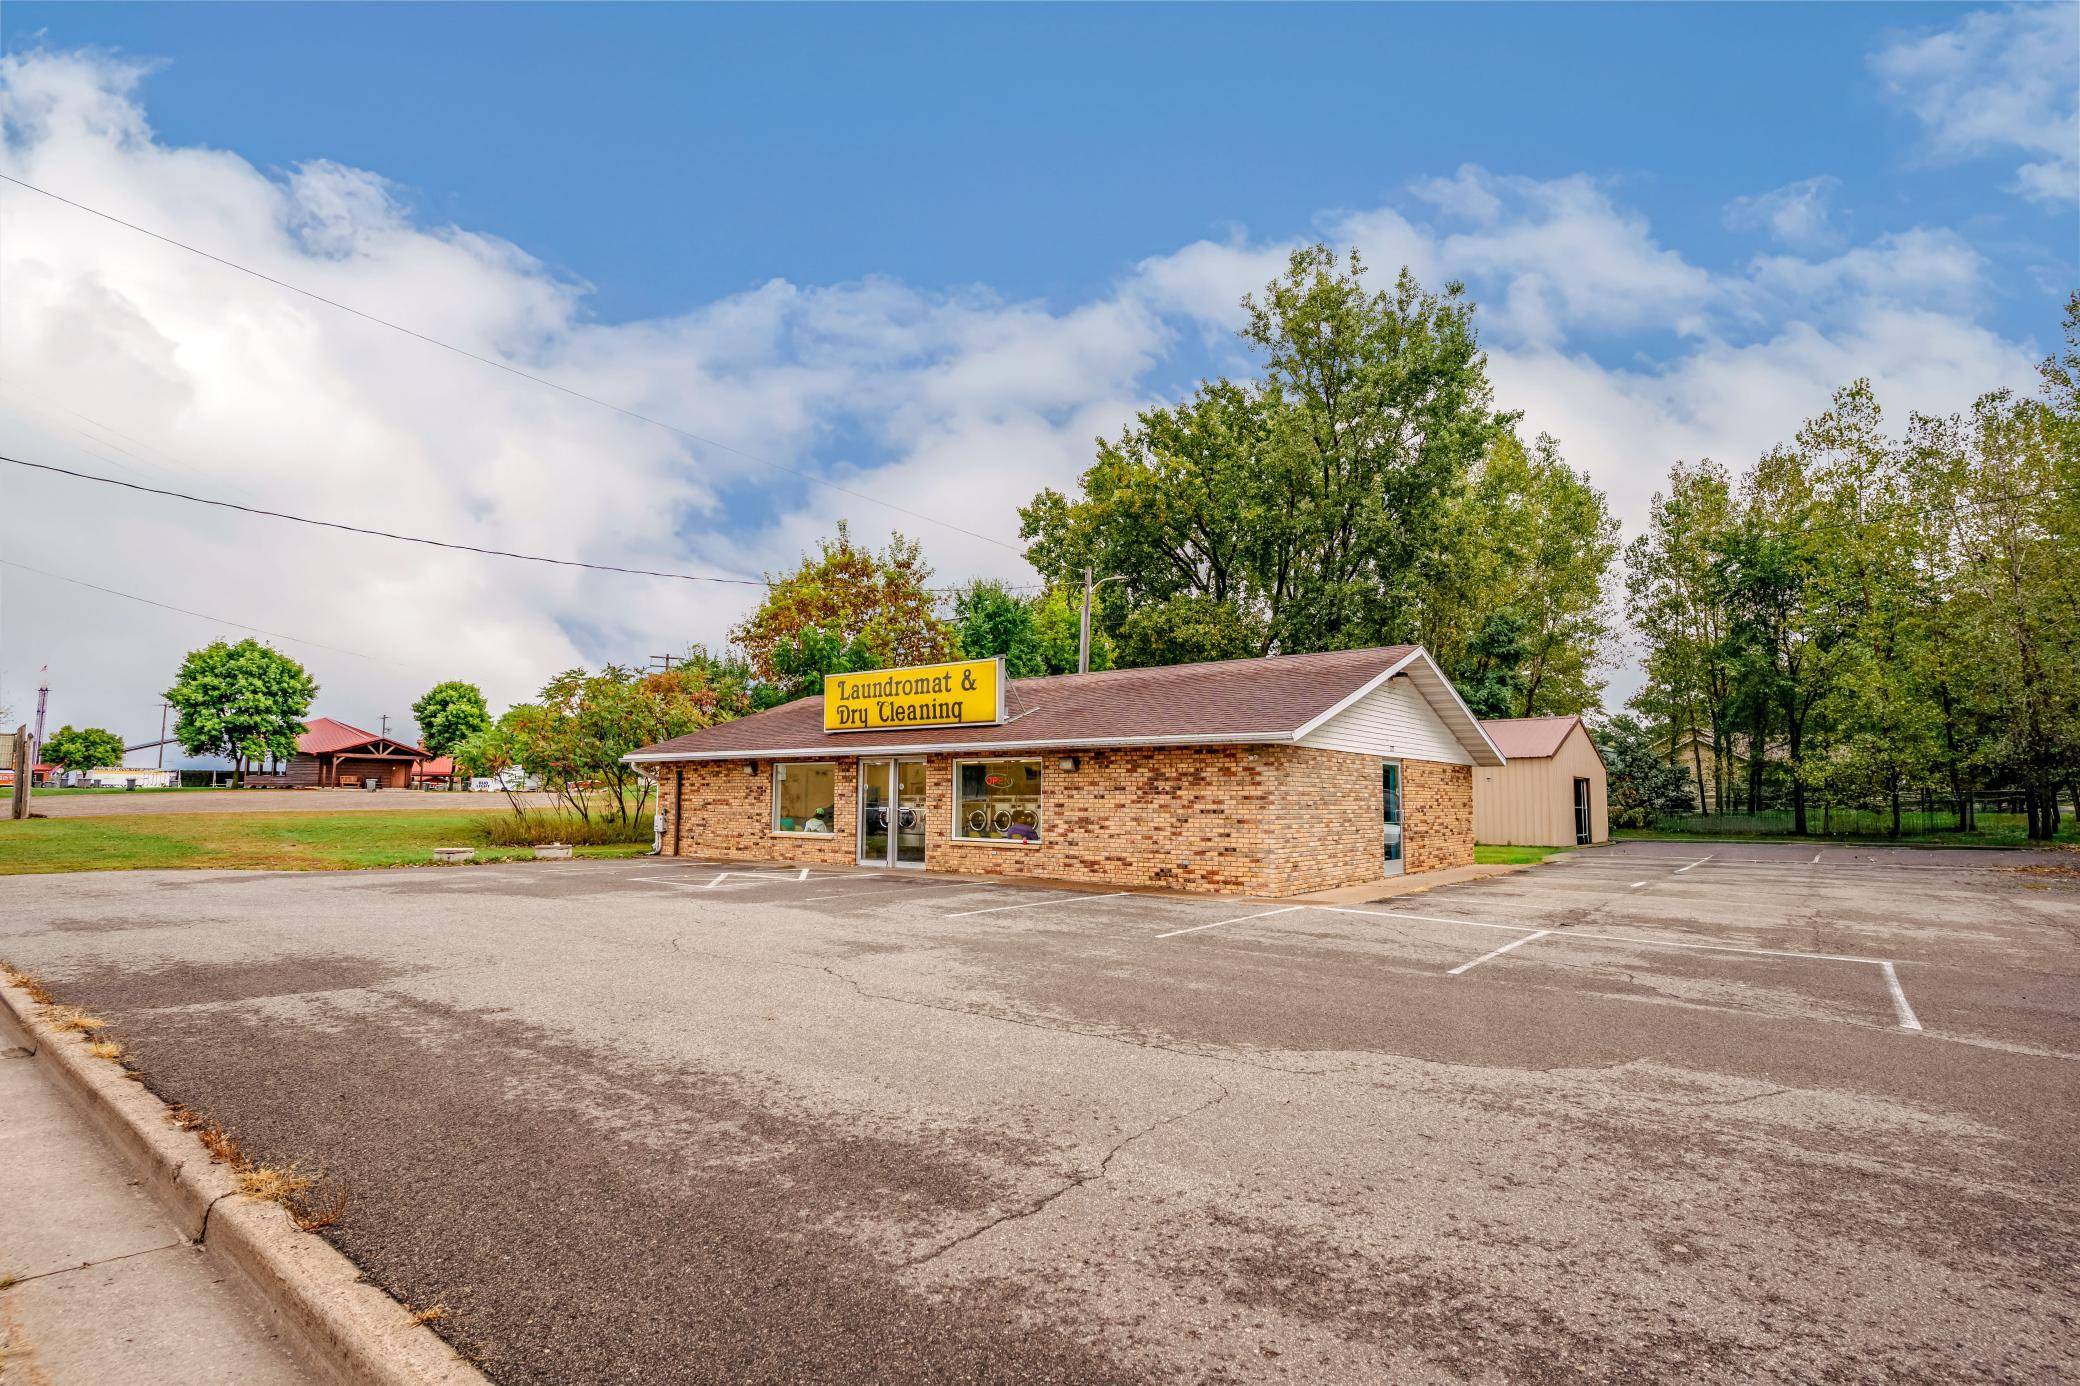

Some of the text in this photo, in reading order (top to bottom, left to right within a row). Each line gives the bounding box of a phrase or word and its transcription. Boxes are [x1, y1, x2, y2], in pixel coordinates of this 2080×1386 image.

[838, 669, 977, 701] Laundromat &
[837, 699, 963, 728] Dry Cleaning
